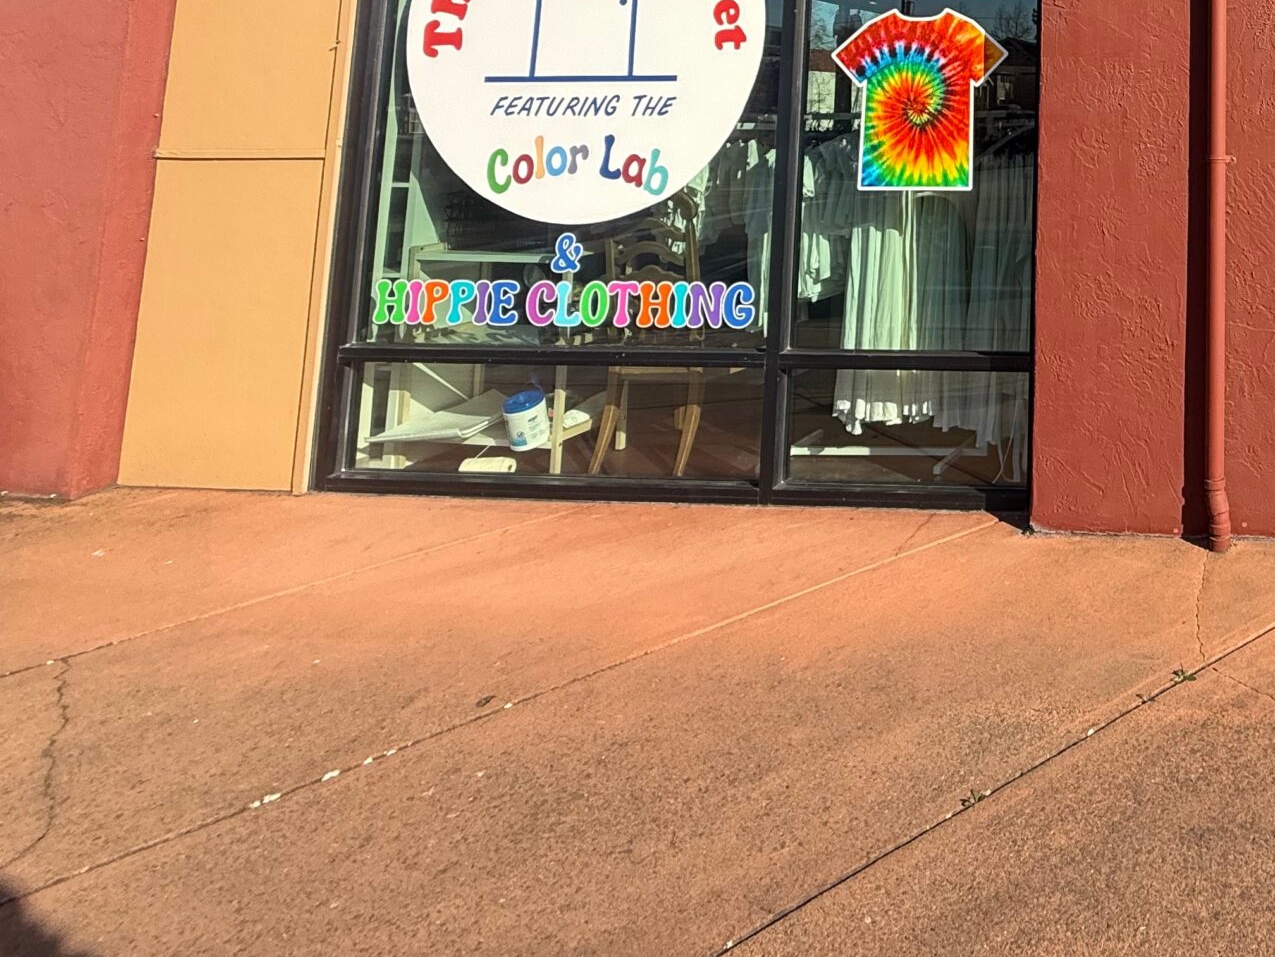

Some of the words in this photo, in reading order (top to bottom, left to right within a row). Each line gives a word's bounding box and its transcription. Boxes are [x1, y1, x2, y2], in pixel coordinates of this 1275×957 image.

[490, 95, 621, 117] FEATURING
[632, 95, 677, 117] THE
[487, 135, 589, 194] Color
[599, 134, 669, 196] Lab
[550, 232, 583, 273] &
[372, 279, 520, 327] HIPPIE
[525, 280, 756, 329] CLOTHING
